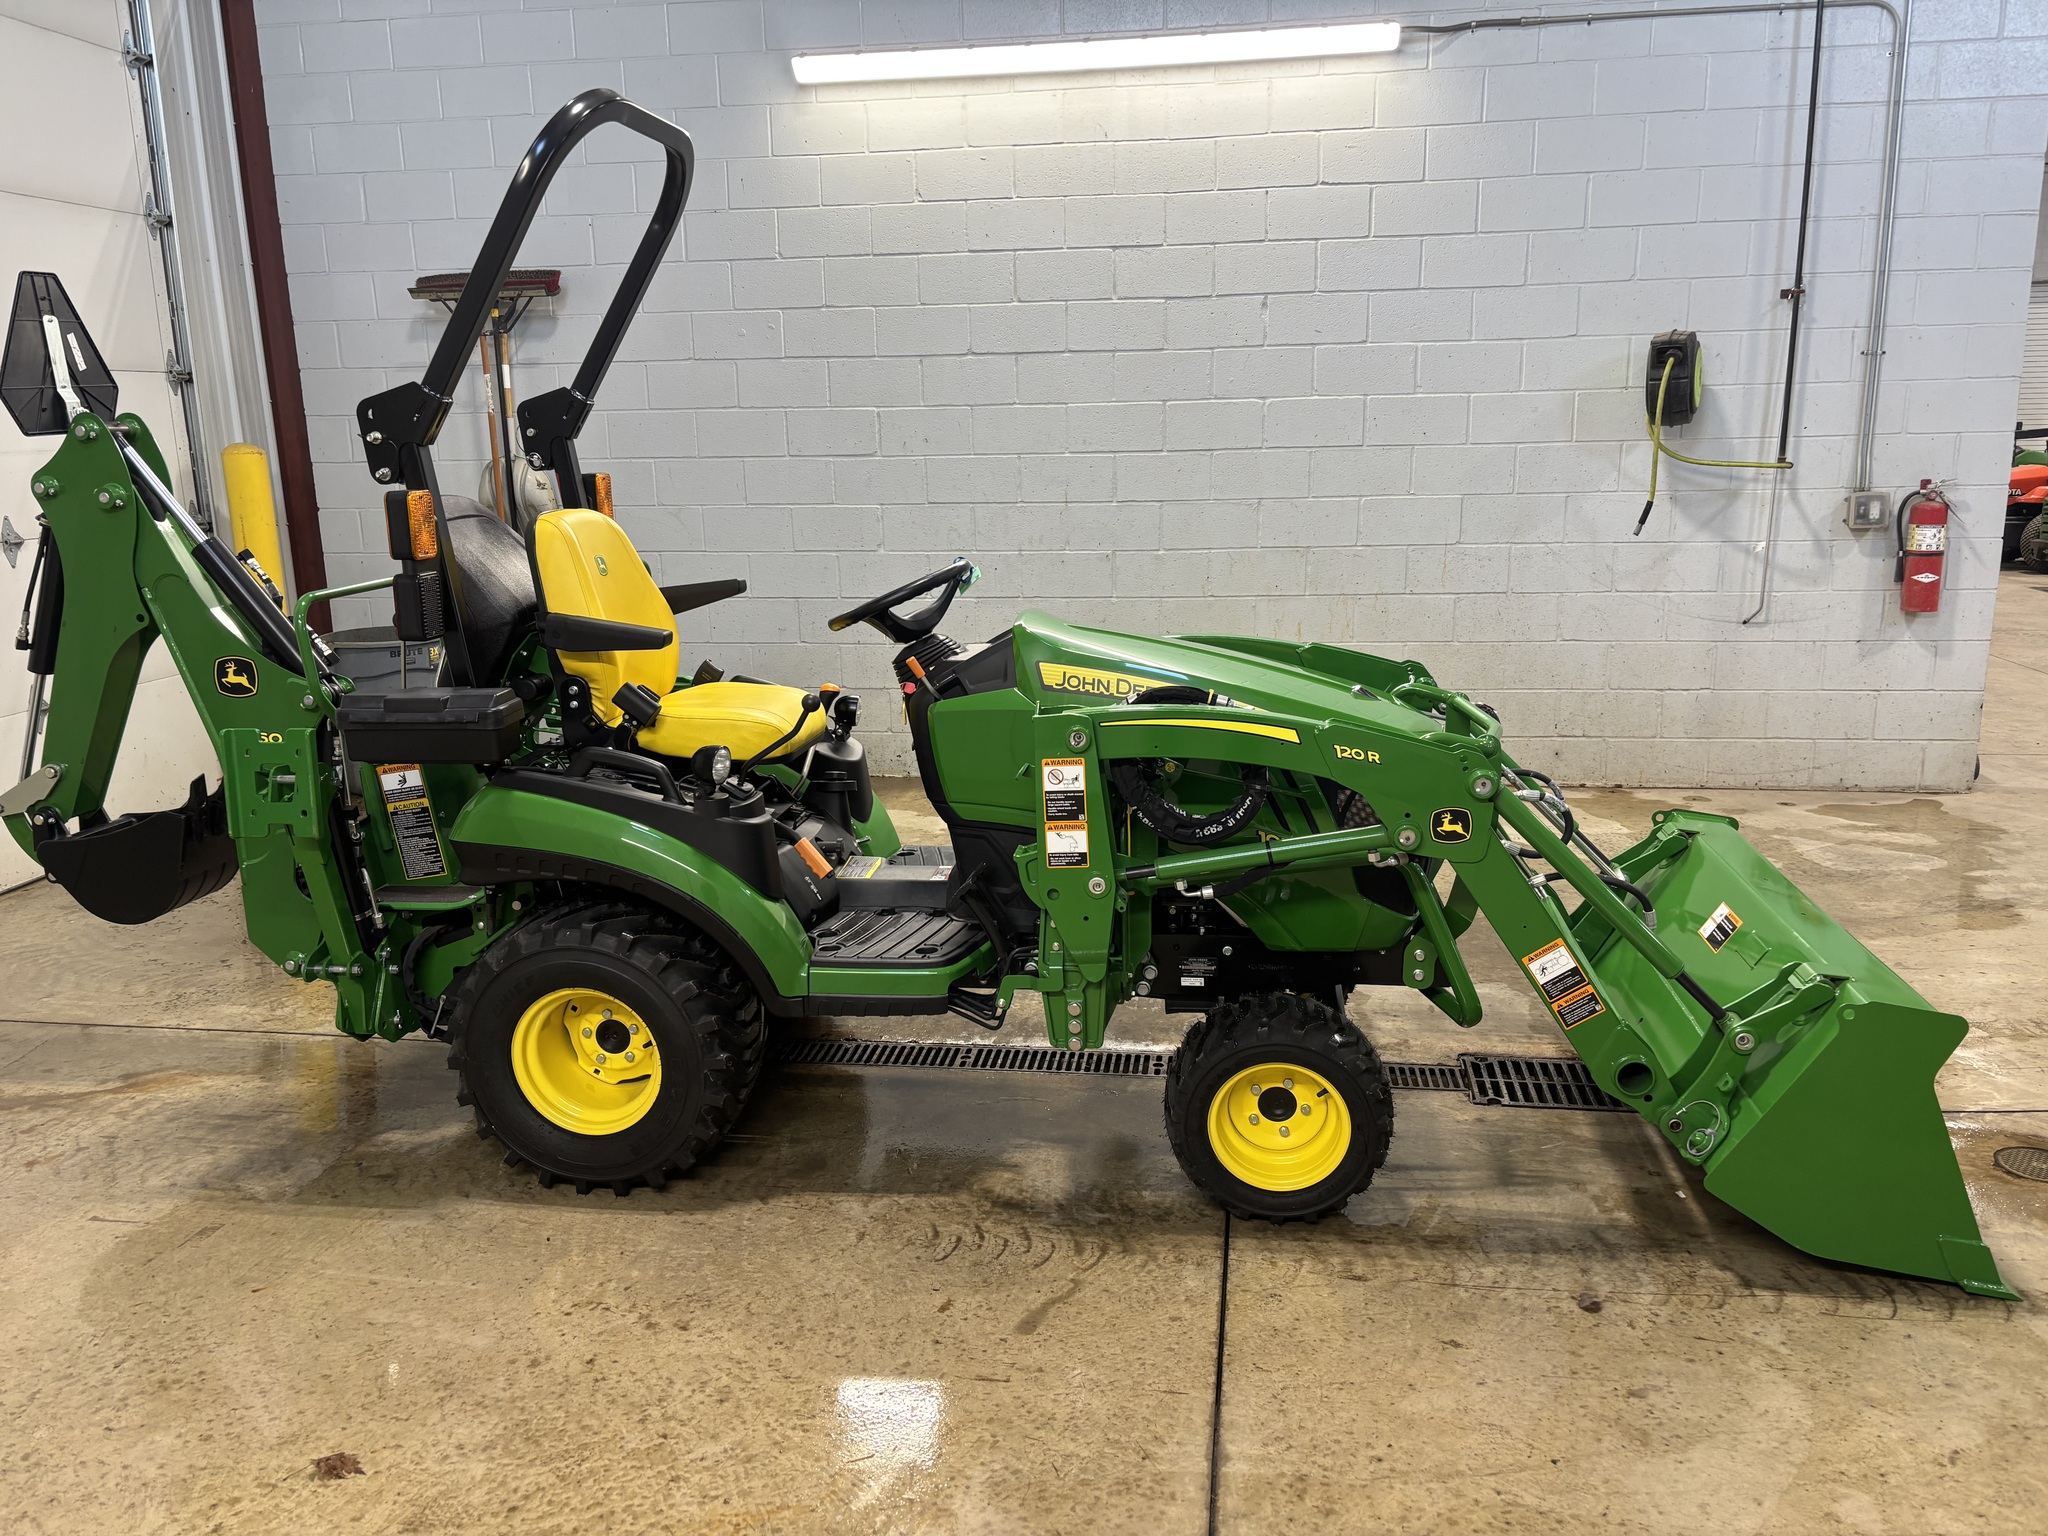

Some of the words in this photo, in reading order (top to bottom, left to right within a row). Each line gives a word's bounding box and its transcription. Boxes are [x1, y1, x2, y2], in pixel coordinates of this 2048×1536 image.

[1054, 671, 1111, 694] JOHN
[1116, 678, 1152, 696] DE
[387, 763, 416, 773] WARNING
[398, 801, 425, 810] CAUTION
[1533, 942, 1560, 959] WARNING
[1563, 988, 1590, 1005] WARNING
